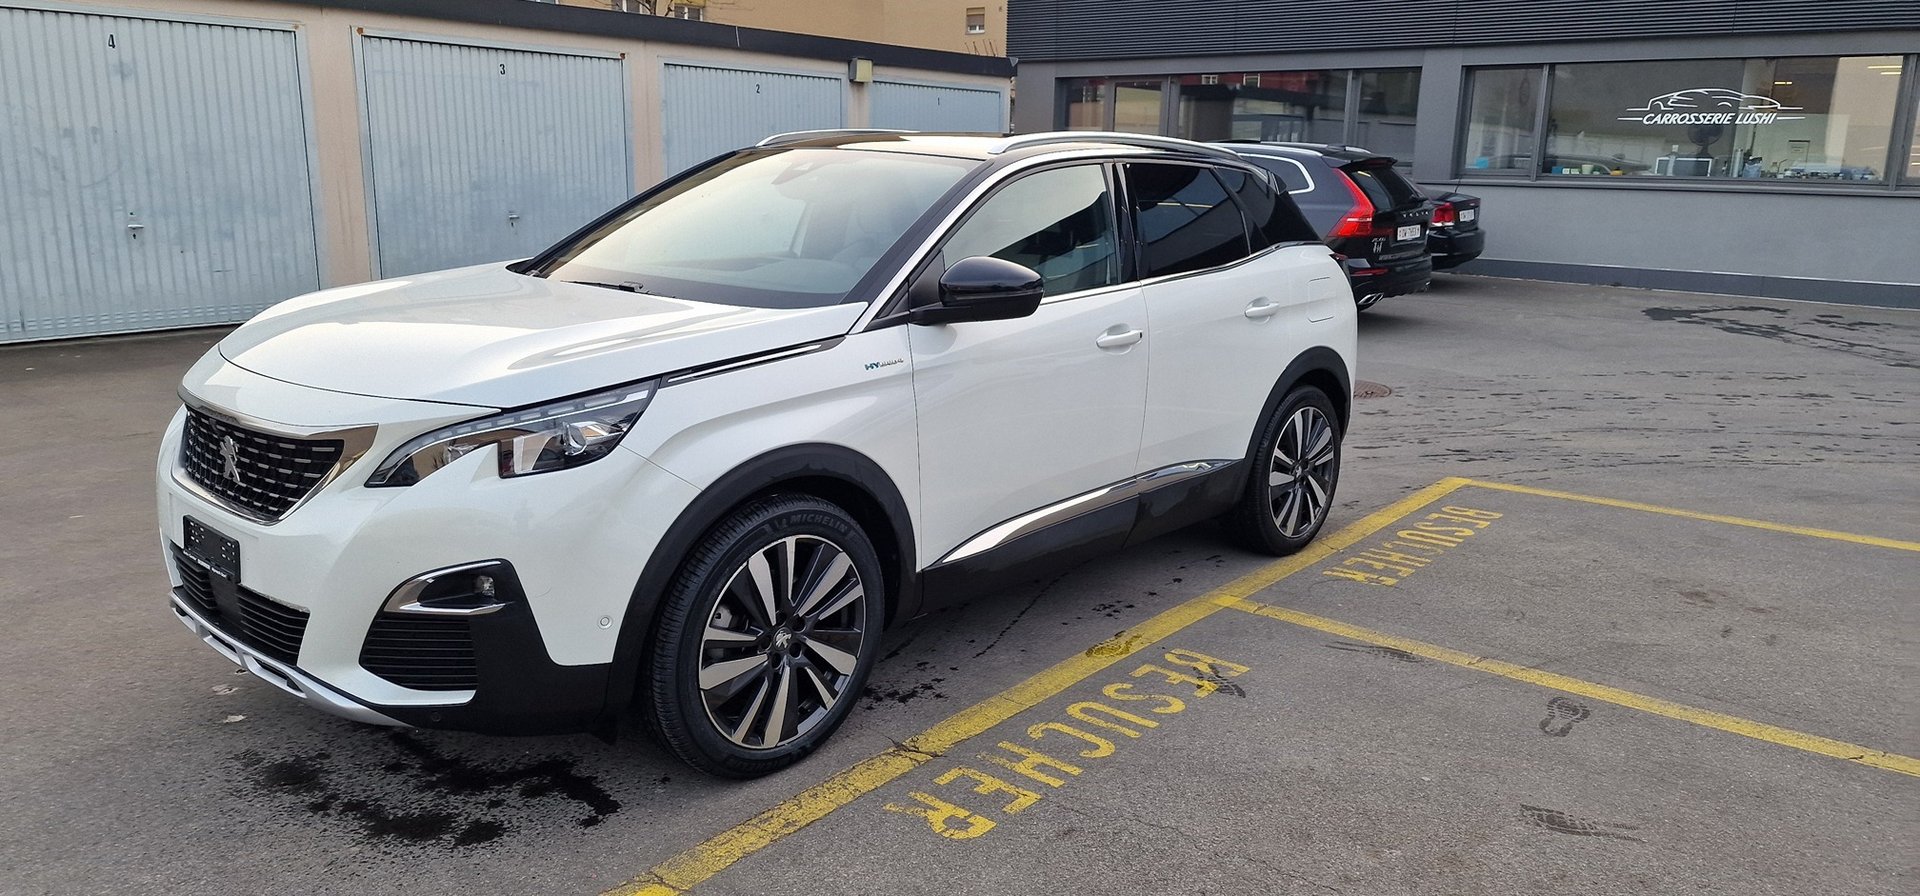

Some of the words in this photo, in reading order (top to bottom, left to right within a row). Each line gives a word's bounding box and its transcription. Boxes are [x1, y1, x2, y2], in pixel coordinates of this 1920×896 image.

[108, 34, 116, 49] 4
[499, 63, 506, 75] 3
[755, 83, 761, 94] 2
[1642, 113, 1735, 125] CARROSSERIE
[1735, 112, 1777, 125] LUSHI
[789, 513, 848, 534] MICHELIN
[1322, 505, 1504, 587] BESUCHER
[883, 648, 1251, 840] BESUCHER
